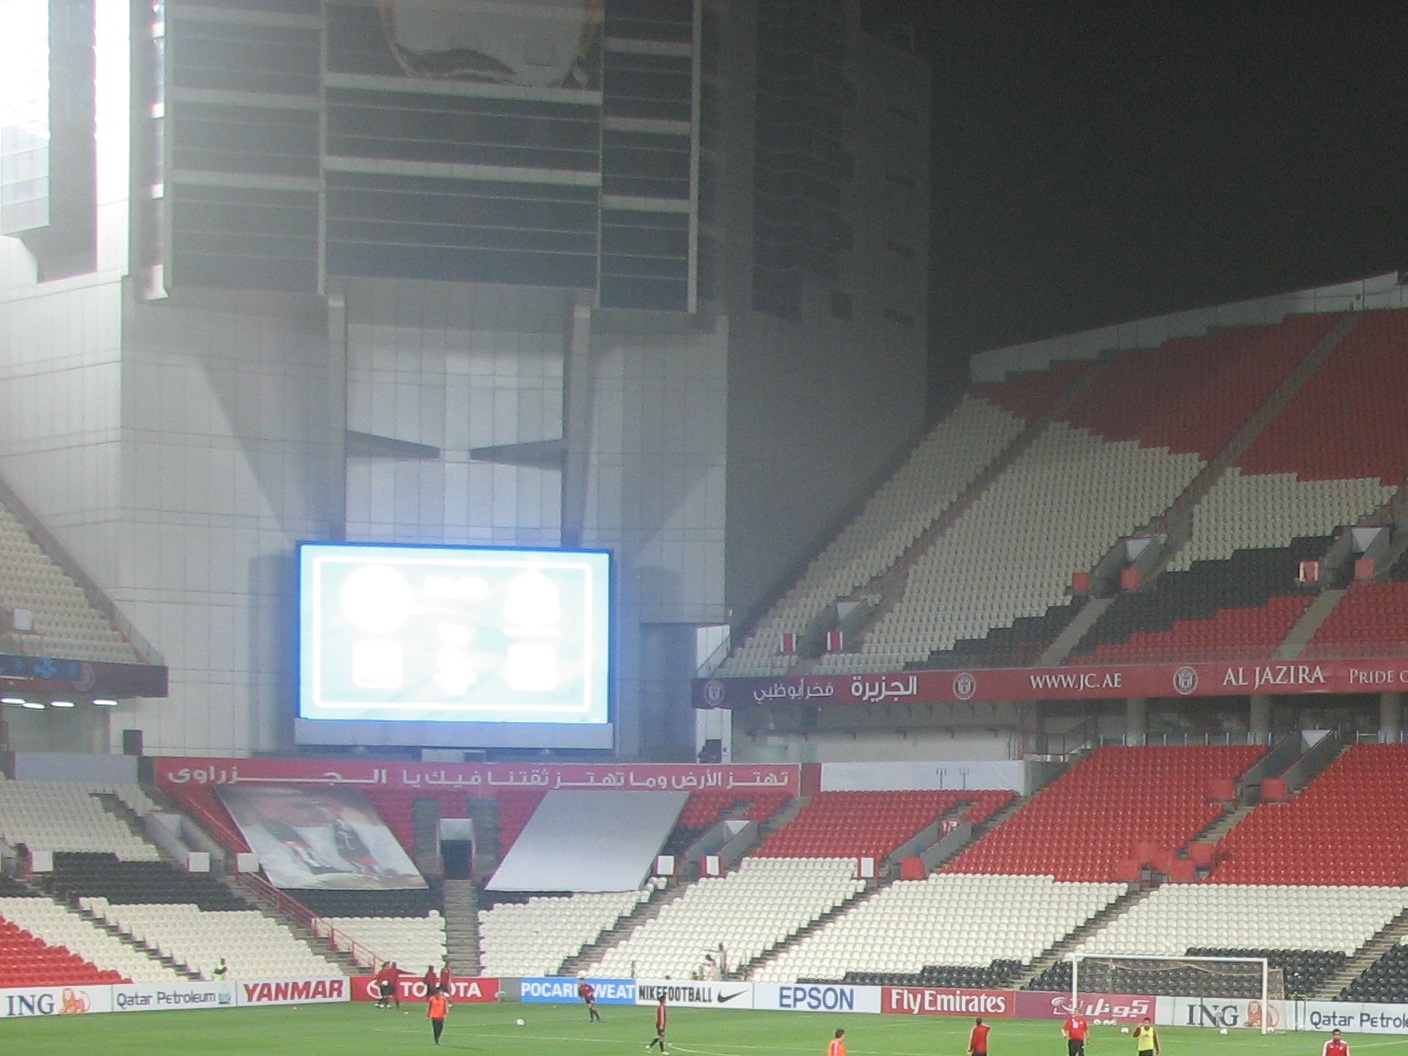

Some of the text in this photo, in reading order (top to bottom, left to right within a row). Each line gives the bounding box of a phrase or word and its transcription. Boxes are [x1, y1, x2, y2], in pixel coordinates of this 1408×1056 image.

[851, 675, 917, 702] الجزيرة
[1222, 665, 1326, 690] AL JAZIRA
[117, 990, 217, 1011] Qatar Petroleum
[243, 977, 345, 1002] YANMAR
[399, 981, 482, 998] TOTA
[521, 982, 635, 1001] POCARI WEAT
[779, 986, 854, 1010] EPSON
[891, 988, 1006, 1015] Fly Emirates
[6, 994, 54, 1016] ING
[1186, 1003, 1239, 1027] ING
[1310, 1010, 1355, 1030] Qatar
